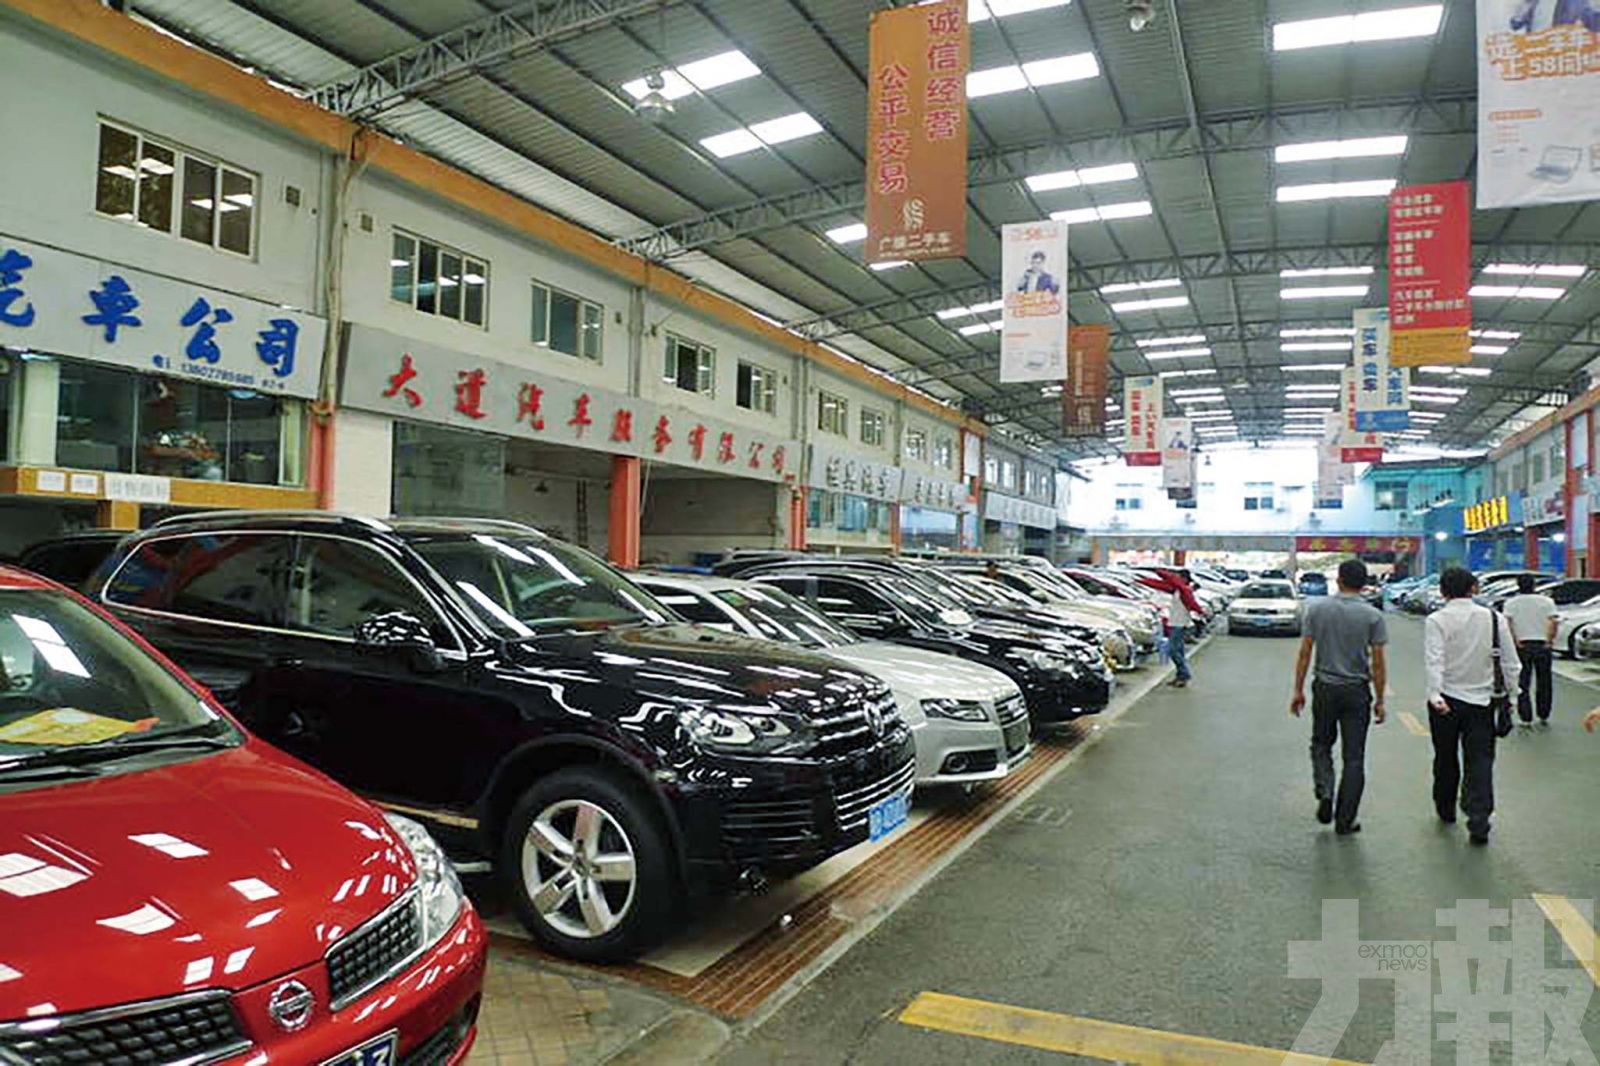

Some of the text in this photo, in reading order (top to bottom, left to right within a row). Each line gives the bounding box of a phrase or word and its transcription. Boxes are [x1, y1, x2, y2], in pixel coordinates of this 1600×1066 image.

[879, 64, 909, 193] 公平交易
[926, 6, 961, 140] 诚信经营
